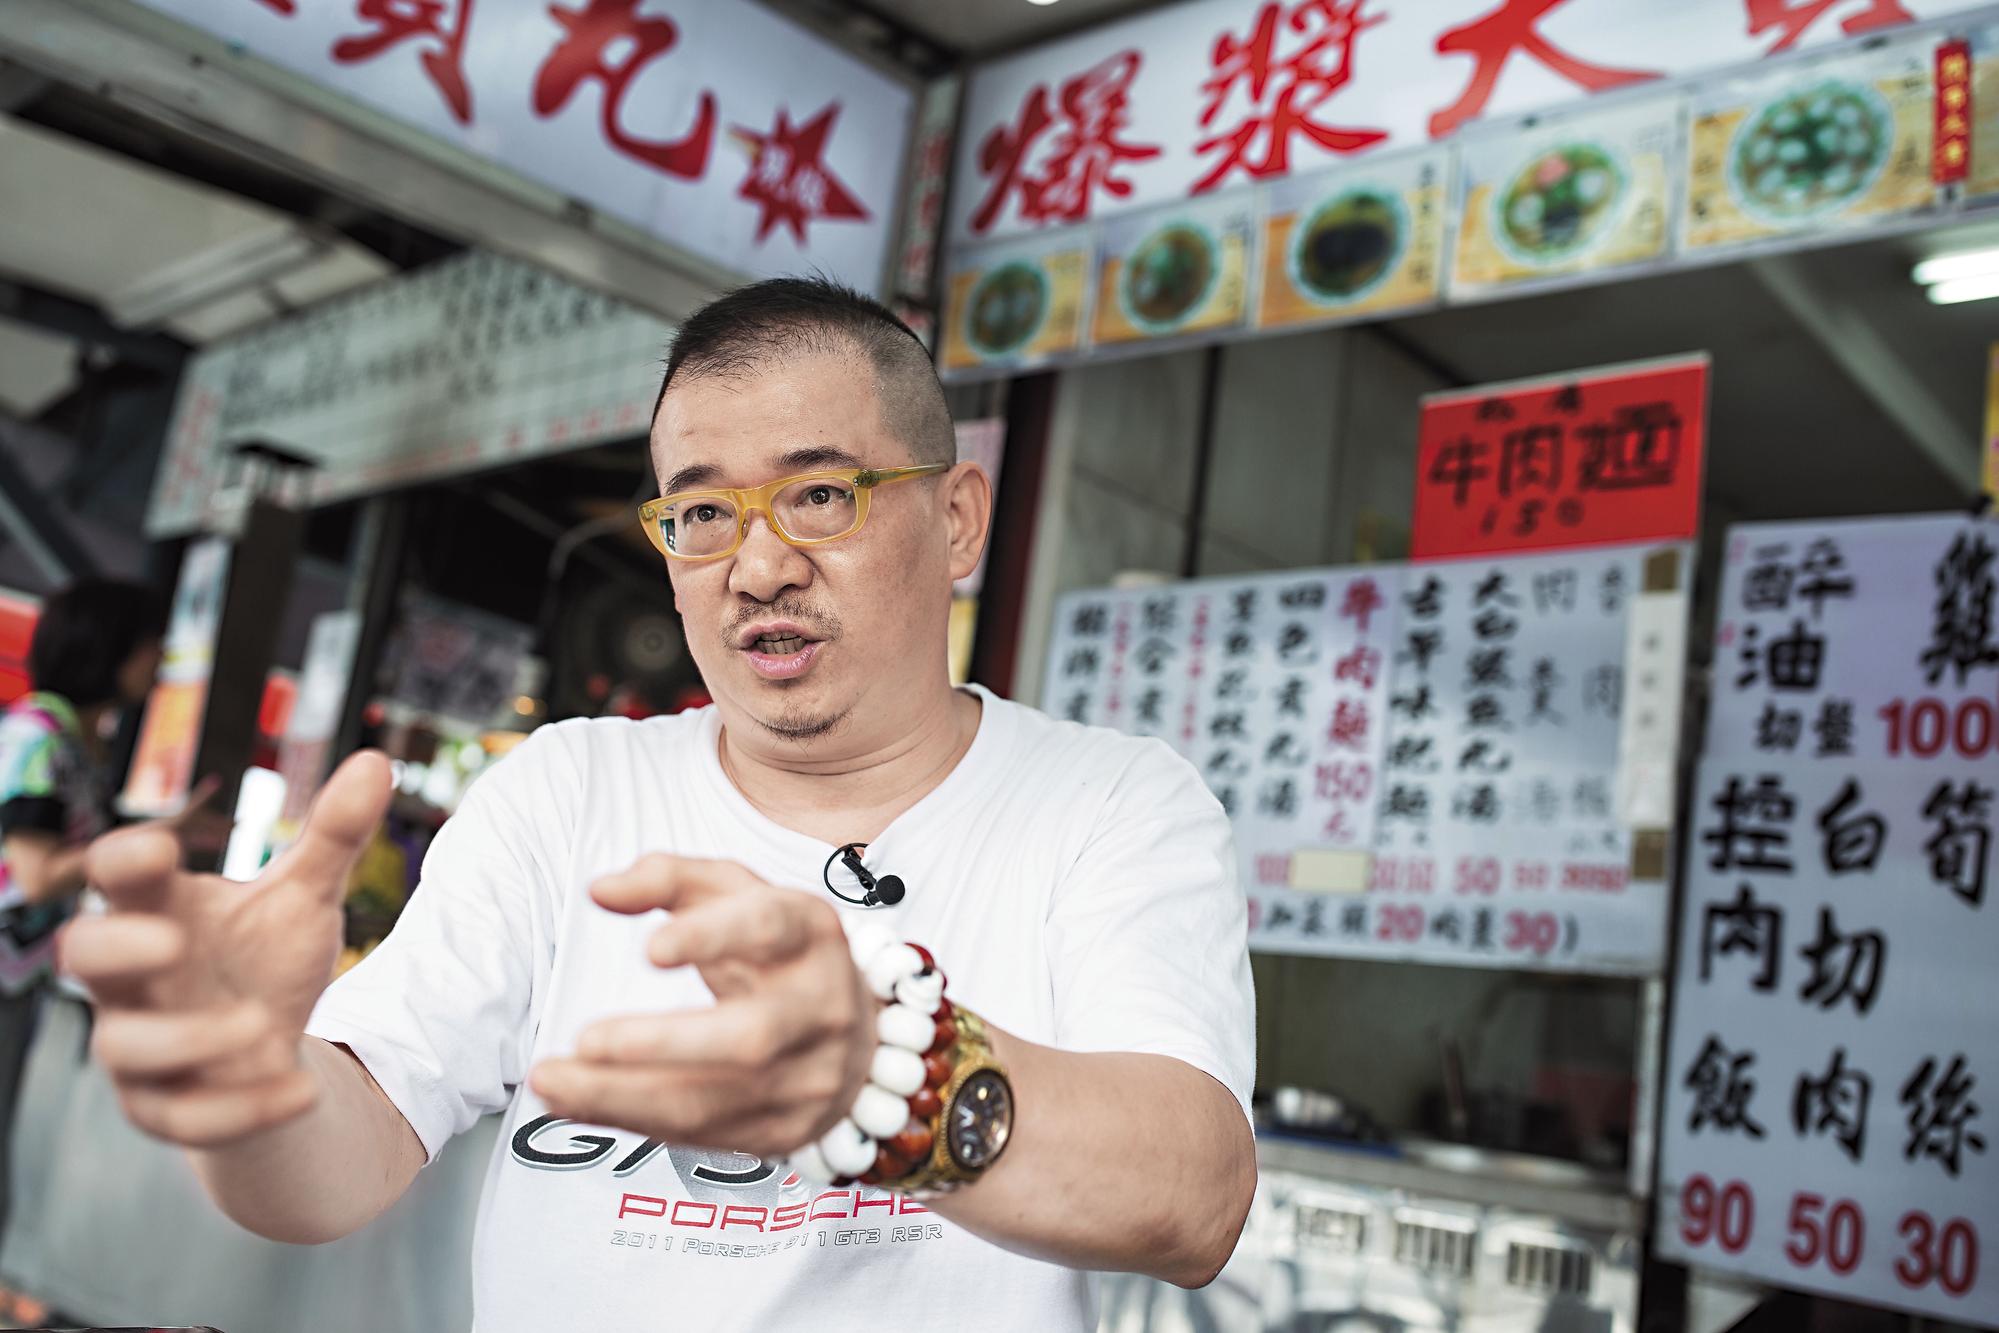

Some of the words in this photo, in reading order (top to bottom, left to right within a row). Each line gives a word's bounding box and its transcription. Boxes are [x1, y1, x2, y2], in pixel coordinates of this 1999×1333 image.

[1683, 772, 1798, 1142] 控肉飯
[1791, 775, 1888, 1164] 白切肉
[611, 1229, 673, 1251] 2011
[834, 1227, 881, 1247] GT3
[890, 1224, 943, 1243] RSR
[618, 1189, 930, 1233] PORSCHE
[1680, 1173, 1755, 1255] 90
[1785, 1192, 1866, 1277] 50
[1894, 1210, 1981, 1298] 30
